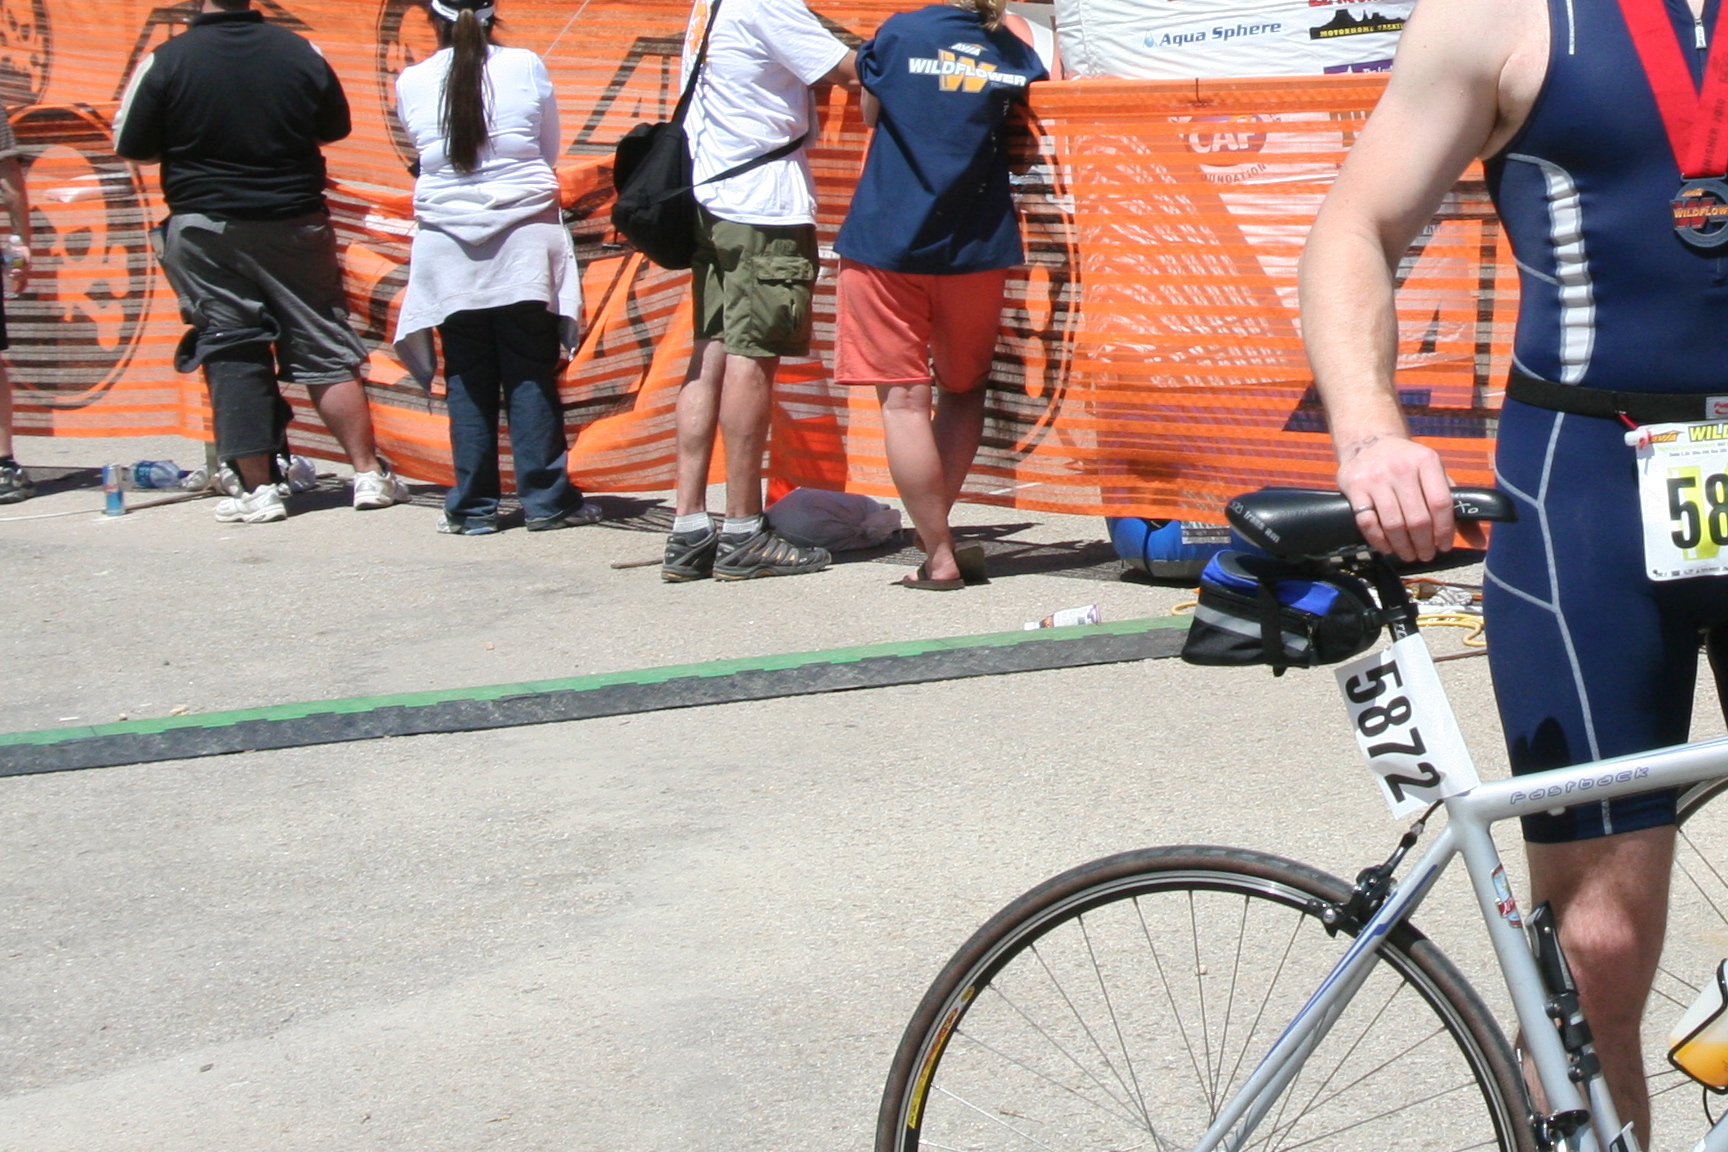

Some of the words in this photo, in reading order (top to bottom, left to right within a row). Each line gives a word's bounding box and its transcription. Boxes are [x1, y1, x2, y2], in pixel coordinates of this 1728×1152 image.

[1158, 29, 1206, 50] Aqua
[1211, 20, 1282, 43] Sphere
[908, 57, 1027, 87] WILDFLOWER
[1345, 659, 1442, 804] 5872
[1510, 765, 1650, 805] Fastback
